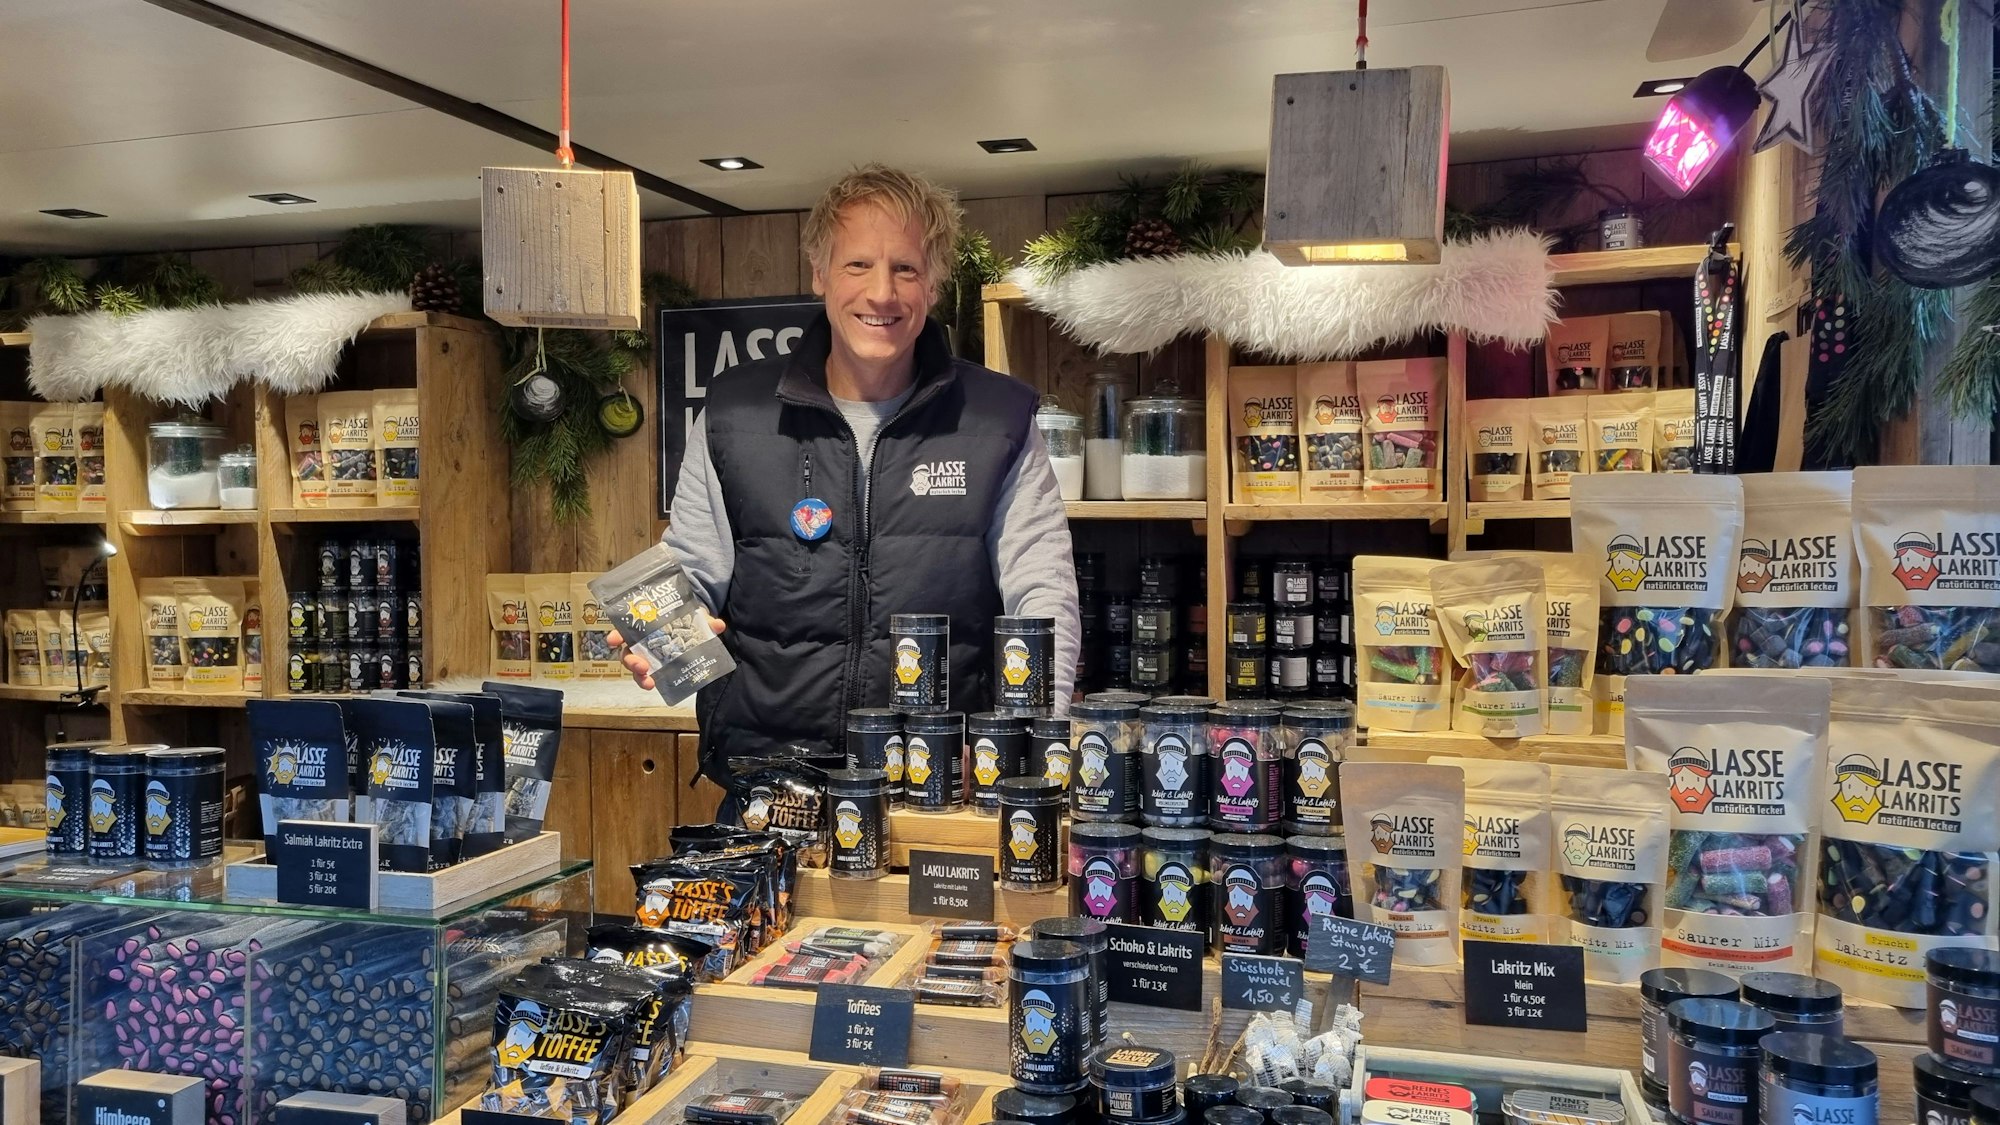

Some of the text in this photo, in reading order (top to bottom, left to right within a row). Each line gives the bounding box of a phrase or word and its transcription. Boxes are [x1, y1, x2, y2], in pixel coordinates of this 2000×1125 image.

[1262, 396, 1293, 410] LASSE
[1396, 391, 1428, 405] LASSE
[1261, 410, 1293, 420] LAKRITS
[1396, 405, 1428, 416] LAKRITS
[343, 419, 368, 428] LASSE
[1492, 426, 1513, 435] LASSE
[1555, 424, 1577, 432] LASSE
[1616, 422, 1638, 430] LASSE
[1616, 430, 1638, 438] LAKRITS
[930, 461, 966, 476] LASSE
[931, 477, 966, 487] LAKRITS
[1643, 535, 1706, 560] LASSE
[1770, 536, 1837, 560] LASSE
[1644, 560, 1707, 579] LAKRITS
[1772, 561, 1837, 580] LAKRITS
[648, 581, 677, 600] LASSE
[1645, 581, 1707, 593] natürlich lecker
[1771, 582, 1839, 593] natürlich lecker
[1940, 580, 1980, 591] natürlich
[204, 607, 228, 616] LASSE
[1395, 602, 1431, 619] LASSE
[1484, 604, 1522, 621] LASSE
[1395, 617, 1429, 628] LAKRITS
[1486, 620, 1523, 633] LAKRITS
[1378, 693, 1405, 702] Saurer
[1473, 701, 1525, 710] Saurer Mix
[513, 731, 543, 747] LASSE
[297, 747, 329, 764] LASSE
[391, 748, 422, 766] LASSE
[508, 745, 538, 759] LAKRITS
[1711, 748, 1784, 778] LASSE
[296, 765, 326, 779] LAKRITS
[388, 765, 420, 780] LAKRITS
[1883, 757, 1963, 792] LASSE
[1712, 779, 1785, 800] LAKRITS
[1714, 803, 1785, 815] natürlich lecker
[1882, 789, 1961, 816] LAKRITS
[771, 805, 821, 830] TOFFEE
[1880, 814, 1959, 832] natürlich lecker
[1393, 815, 1434, 835] LASSE
[1478, 816, 1520, 835] LASSE
[284, 833, 363, 850] Salmiak Lakritz Extra
[1393, 834, 1434, 848] LAKRITS
[1479, 834, 1520, 849] LAKRITS
[1591, 826, 1635, 847] LASSE
[1591, 845, 1635, 861] LAKRITS
[317, 858, 326, 868] für
[327, 860, 335, 869] 5€
[309, 871, 337, 882] 3 für 13€
[923, 864, 980, 880] LAKU LAKRITS
[309, 883, 337, 895] 5 für 20€
[674, 880, 734, 904] LASSE'S
[933, 896, 938, 904] 1
[939, 896, 949, 905] für
[671, 898, 730, 922] TOFFEE
[1322, 917, 1358, 937] Reine
[1416, 923, 1433, 931] Mix
[1503, 926, 1521, 934] Mix
[1570, 932, 1634, 949] Lakritz Mix
[1678, 928, 1780, 949] Saurer Mix
[1871, 936, 1911, 949] Frucht
[1109, 937, 1193, 959] Schoko & Lakrits
[1330, 935, 1379, 957] Stange
[1834, 938, 1908, 966] Lakritz
[1123, 960, 1178, 973] verschiedene Sorten
[1339, 955, 1376, 973] 2 €
[1491, 959, 1555, 977] Lakritz Mix
[1132, 977, 1168, 991] 1 für 13€
[1514, 979, 1533, 990] klein
[1241, 988, 1292, 1005] 1,50 €
[1503, 993, 1509, 1002] 1
[1510, 993, 1521, 1003] für
[847, 999, 881, 1016] Toffees
[1507, 1006, 1543, 1018] 3 für 12€
[847, 1024, 875, 1036] 1 für 2€
[537, 1032, 602, 1063] TOFFEE
[845, 1038, 873, 1050] 3 für 5€
[1115, 1048, 1160, 1058] LAKRITZ
[561, 1065, 579, 1074] Lakritz
[1410, 1083, 1450, 1094] REINES
[1410, 1091, 1450, 1100] LAKRITS
[1109, 1091, 1132, 1101] LAKRITZ
[1550, 1095, 1589, 1106] REINES
[1109, 1100, 1132, 1110] PULVER
[1550, 1102, 1588, 1112] LAKRITS
[95, 1106, 151, 1125] Himbeere
[1410, 1108, 1450, 1117] REINES
[1410, 1115, 1450, 1123] LAKRITS
[1815, 1107, 1854, 1124] LASSE
